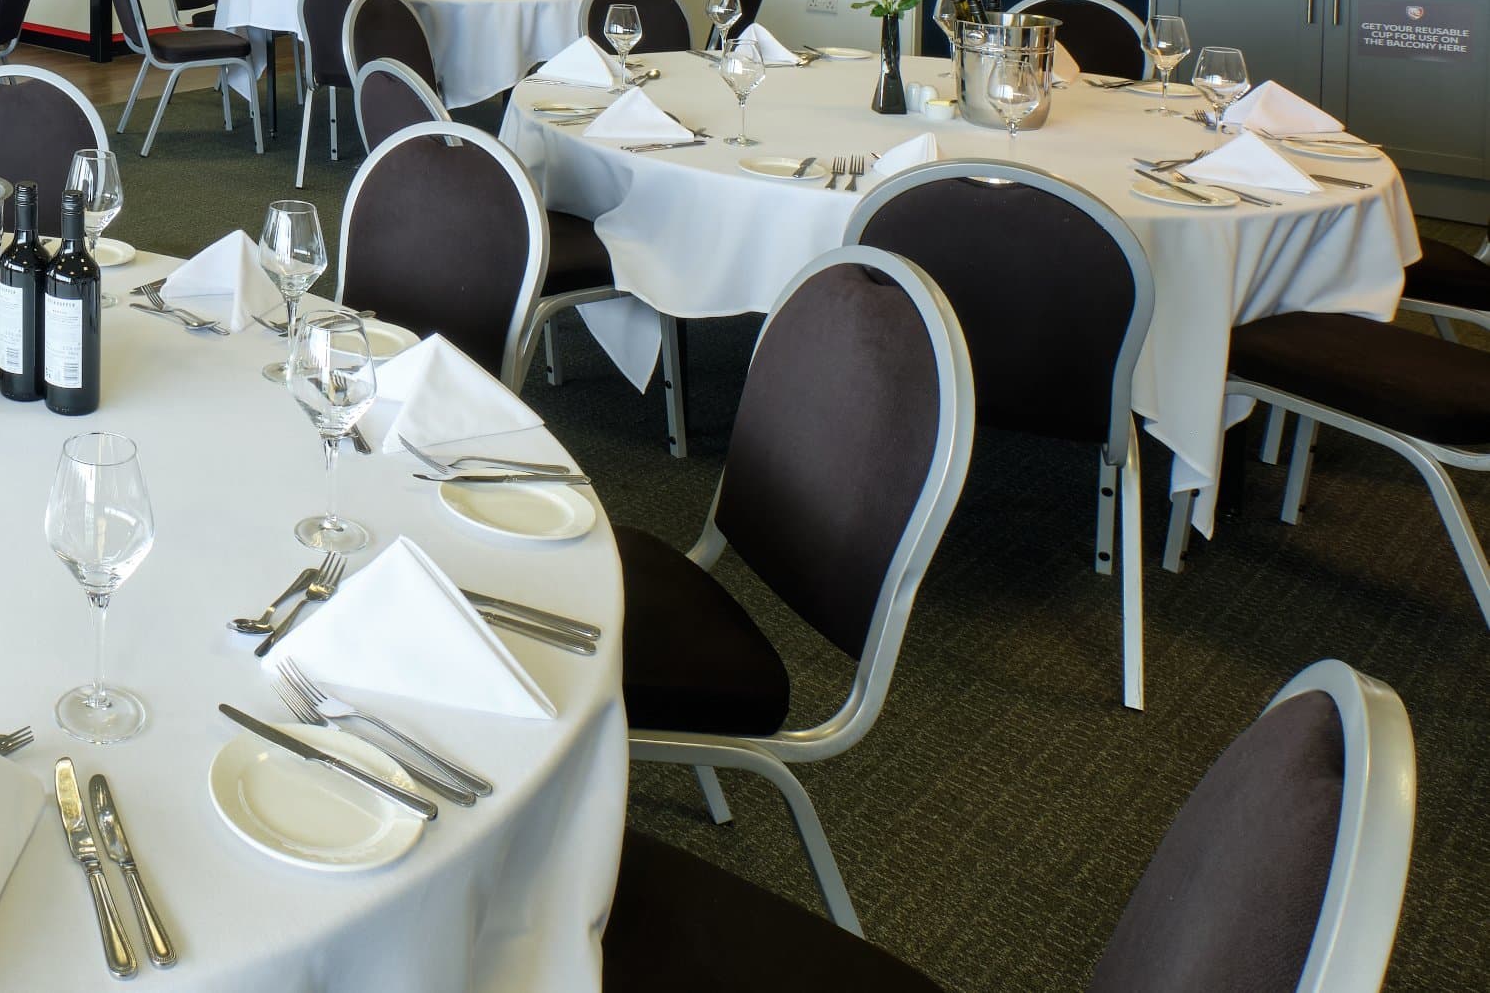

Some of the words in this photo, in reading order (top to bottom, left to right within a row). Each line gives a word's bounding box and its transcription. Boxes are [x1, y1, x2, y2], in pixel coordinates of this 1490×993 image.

[1361, 22, 1382, 30] GET
[1383, 23, 1413, 33] YOUR
[1415, 26, 1470, 37] REUSABLE
[1371, 30, 1393, 39] CUP
[1394, 32, 1416, 41] FOR
[1418, 34, 1439, 43] USE
[1440, 36, 1459, 44] ON
[1363, 37, 1384, 46] THE
[1386, 39, 1437, 50] BALCONY
[1438, 43, 1467, 53] HERE
